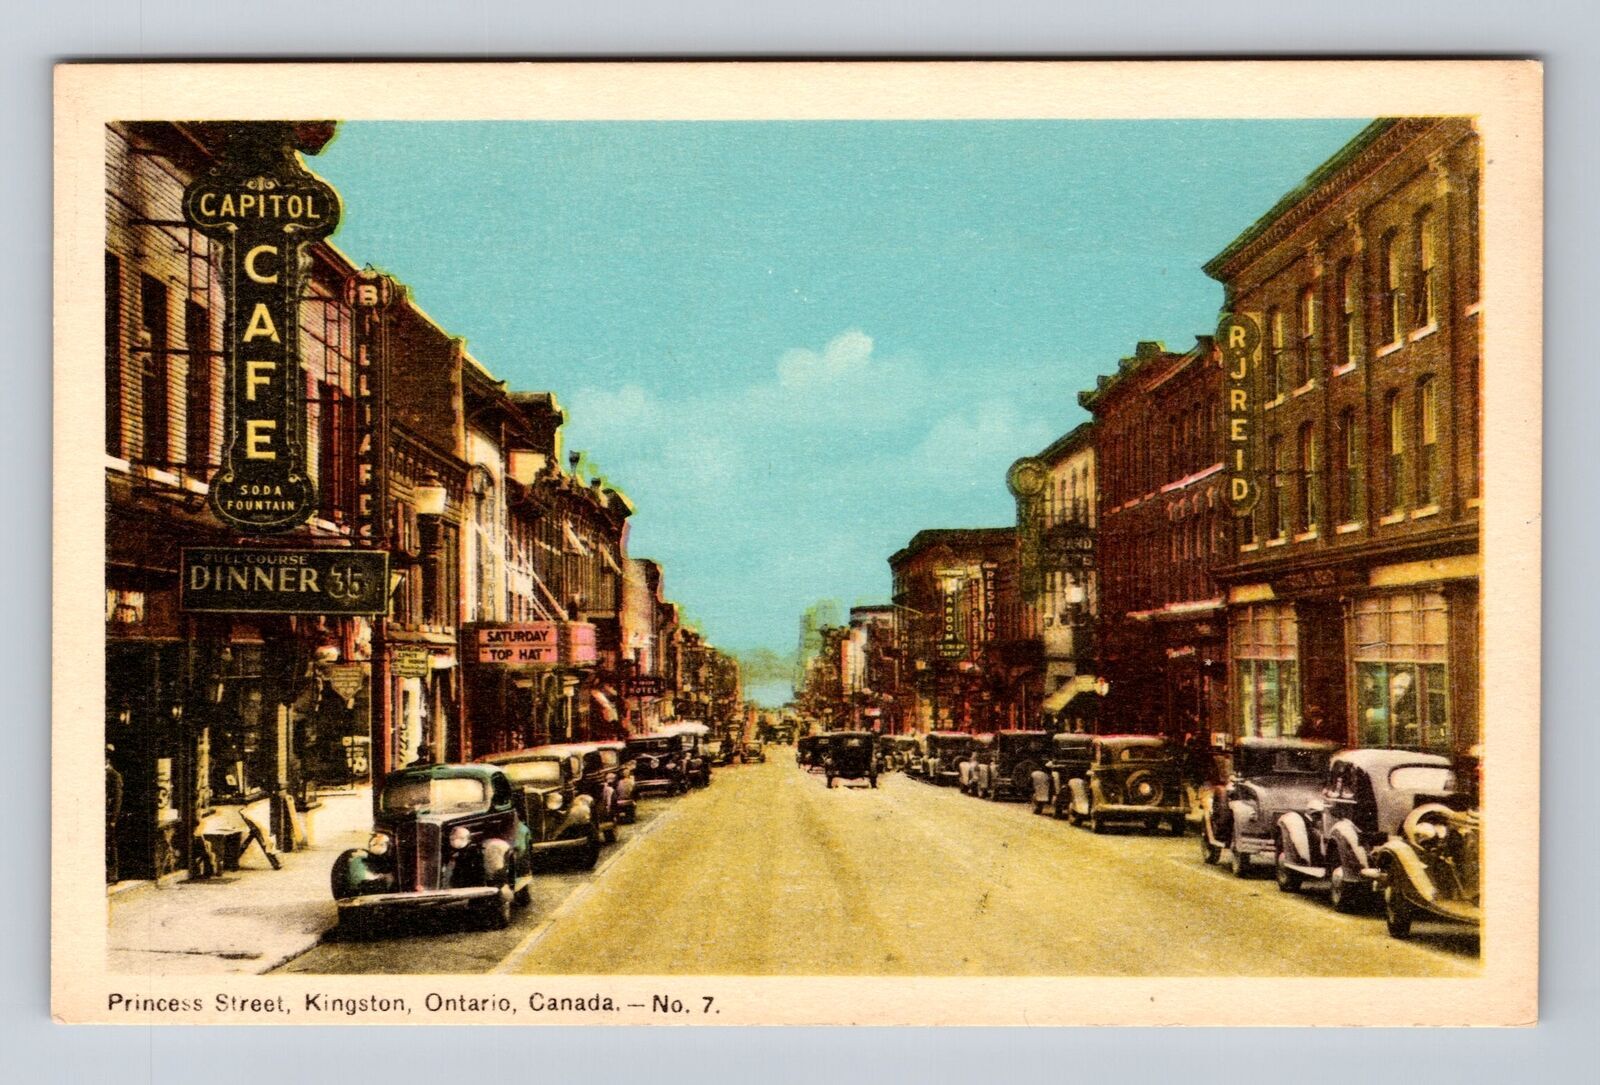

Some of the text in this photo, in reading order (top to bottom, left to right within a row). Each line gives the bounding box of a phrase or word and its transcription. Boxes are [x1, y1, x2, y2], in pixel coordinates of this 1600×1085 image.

[201, 193, 320, 218] CAPITOL
[243, 244, 281, 460] CAFE
[240, 484, 282, 497] SODA
[226, 500, 296, 512] FOUNTAIN
[246, 553, 309, 565] COURSE
[190, 565, 321, 593] DINNER
[487, 630, 549, 642] SATURDAY
